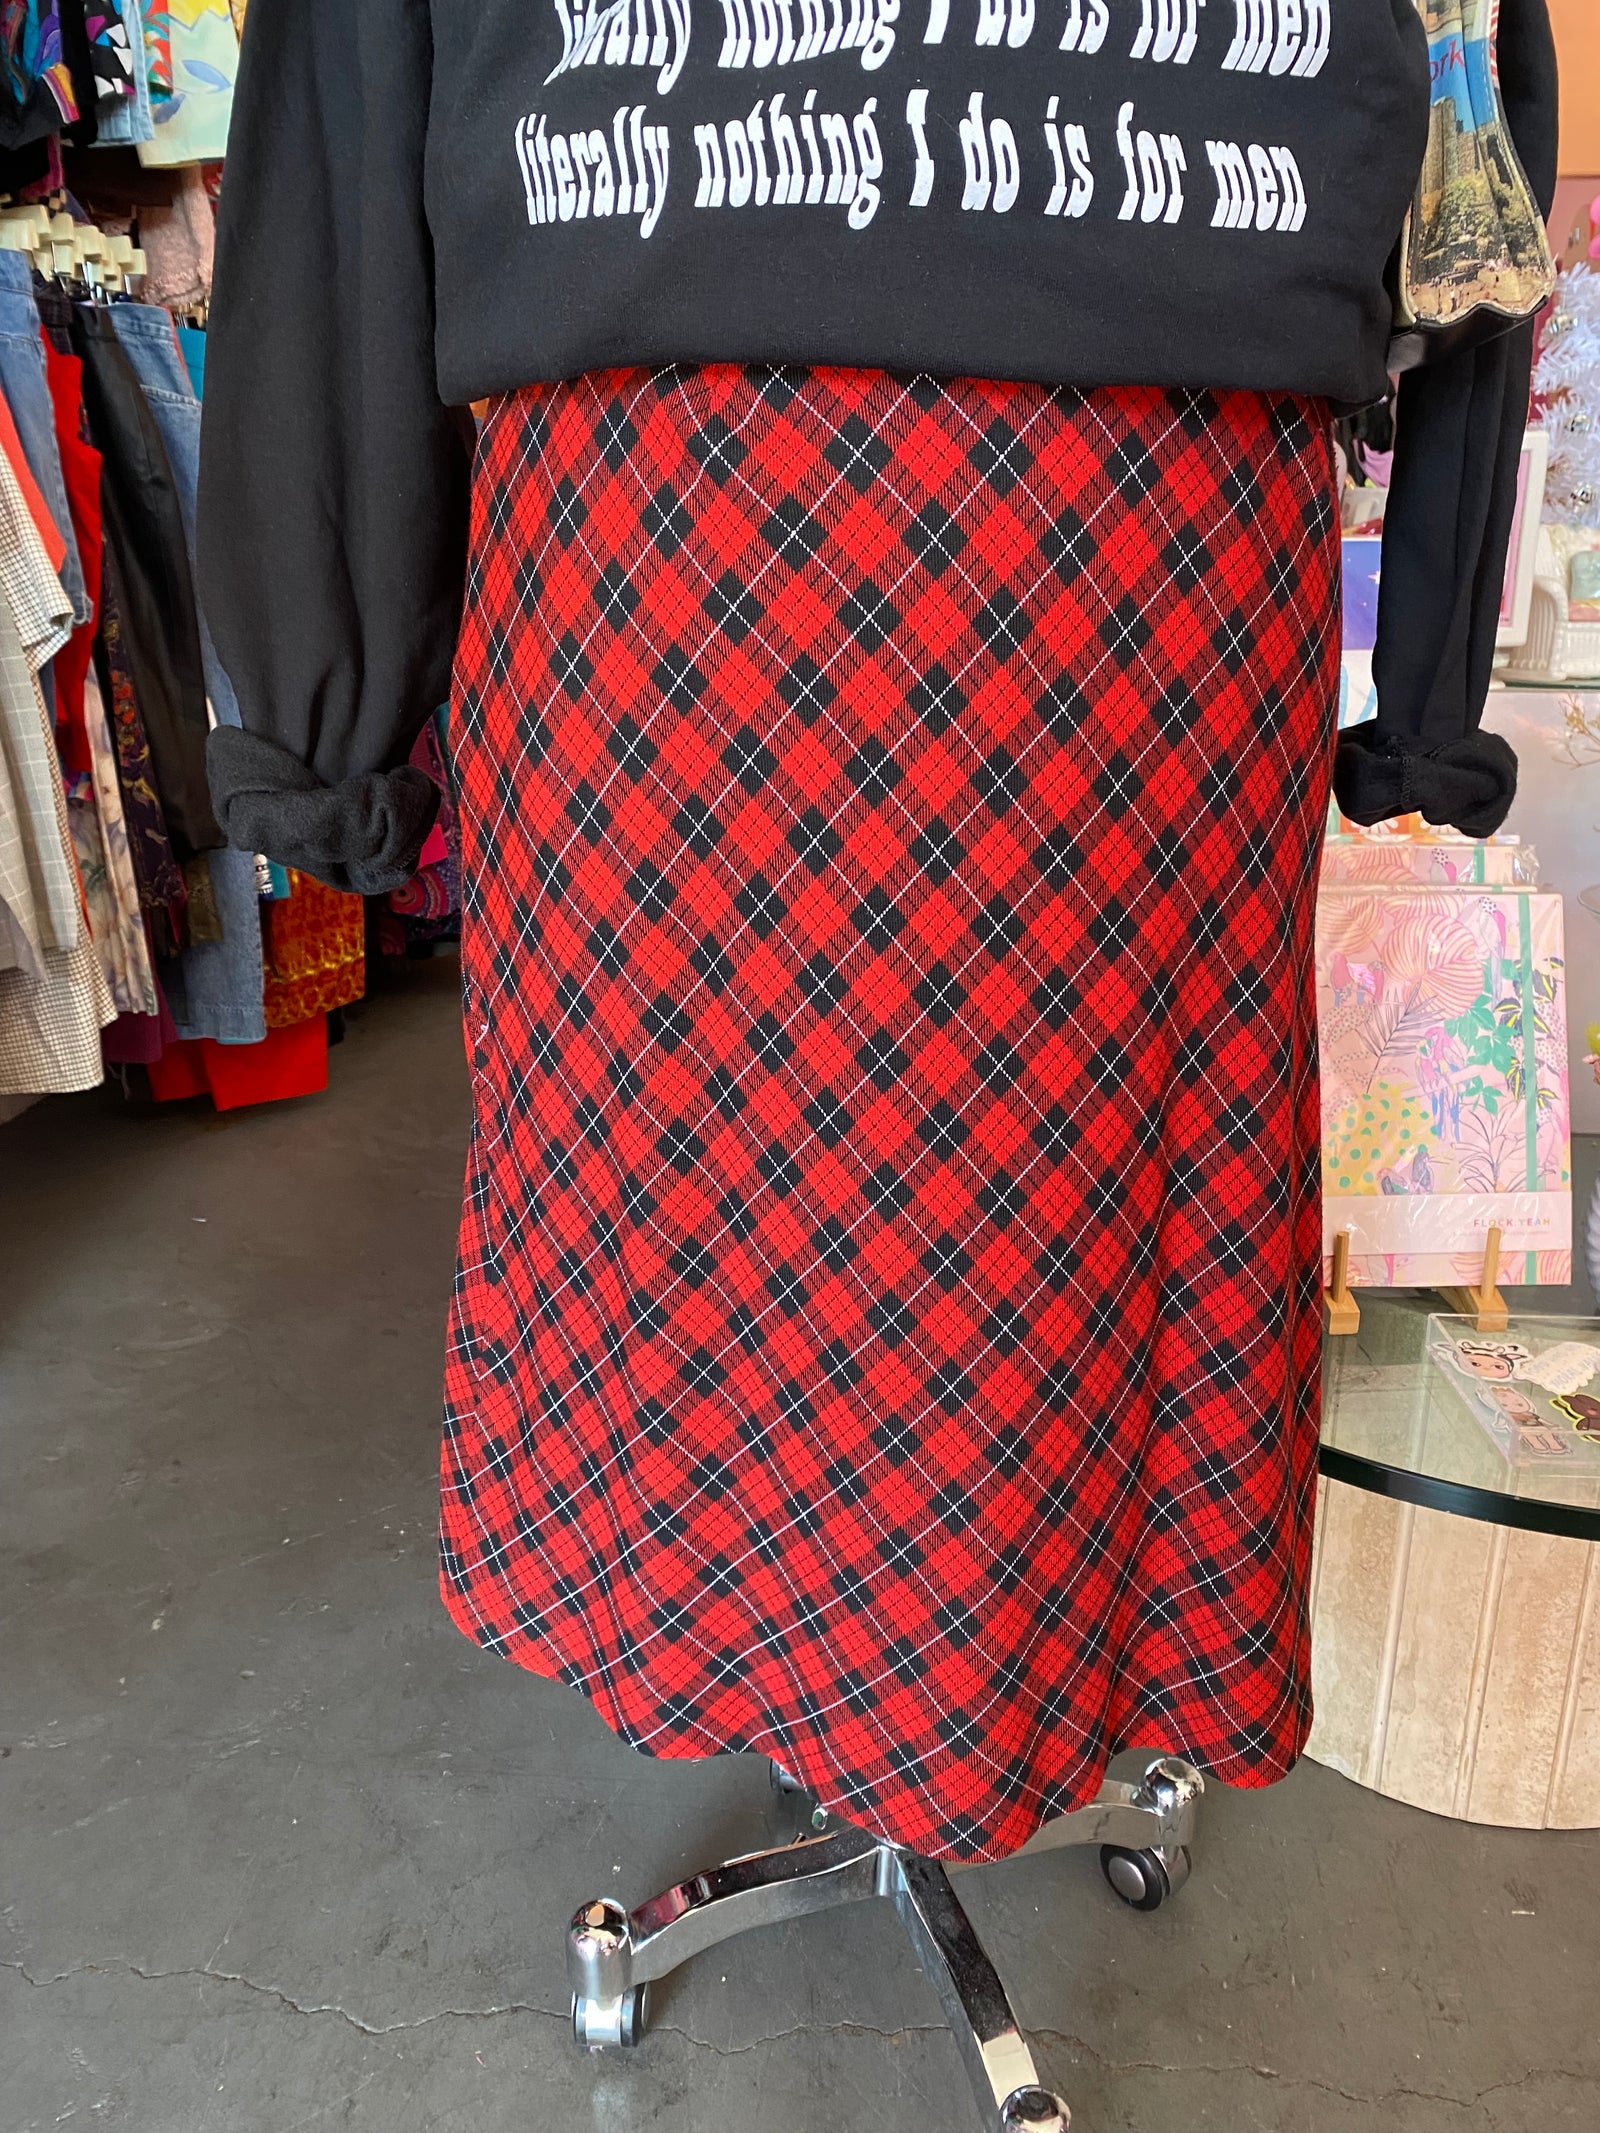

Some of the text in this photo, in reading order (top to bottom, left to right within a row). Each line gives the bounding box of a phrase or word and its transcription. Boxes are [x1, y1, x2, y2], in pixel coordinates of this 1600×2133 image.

[1221, 0, 1330, 77] men
[515, 89, 1307, 239] literally nothing I do is for men
[1519, 1217, 1551, 1227] YEAH
